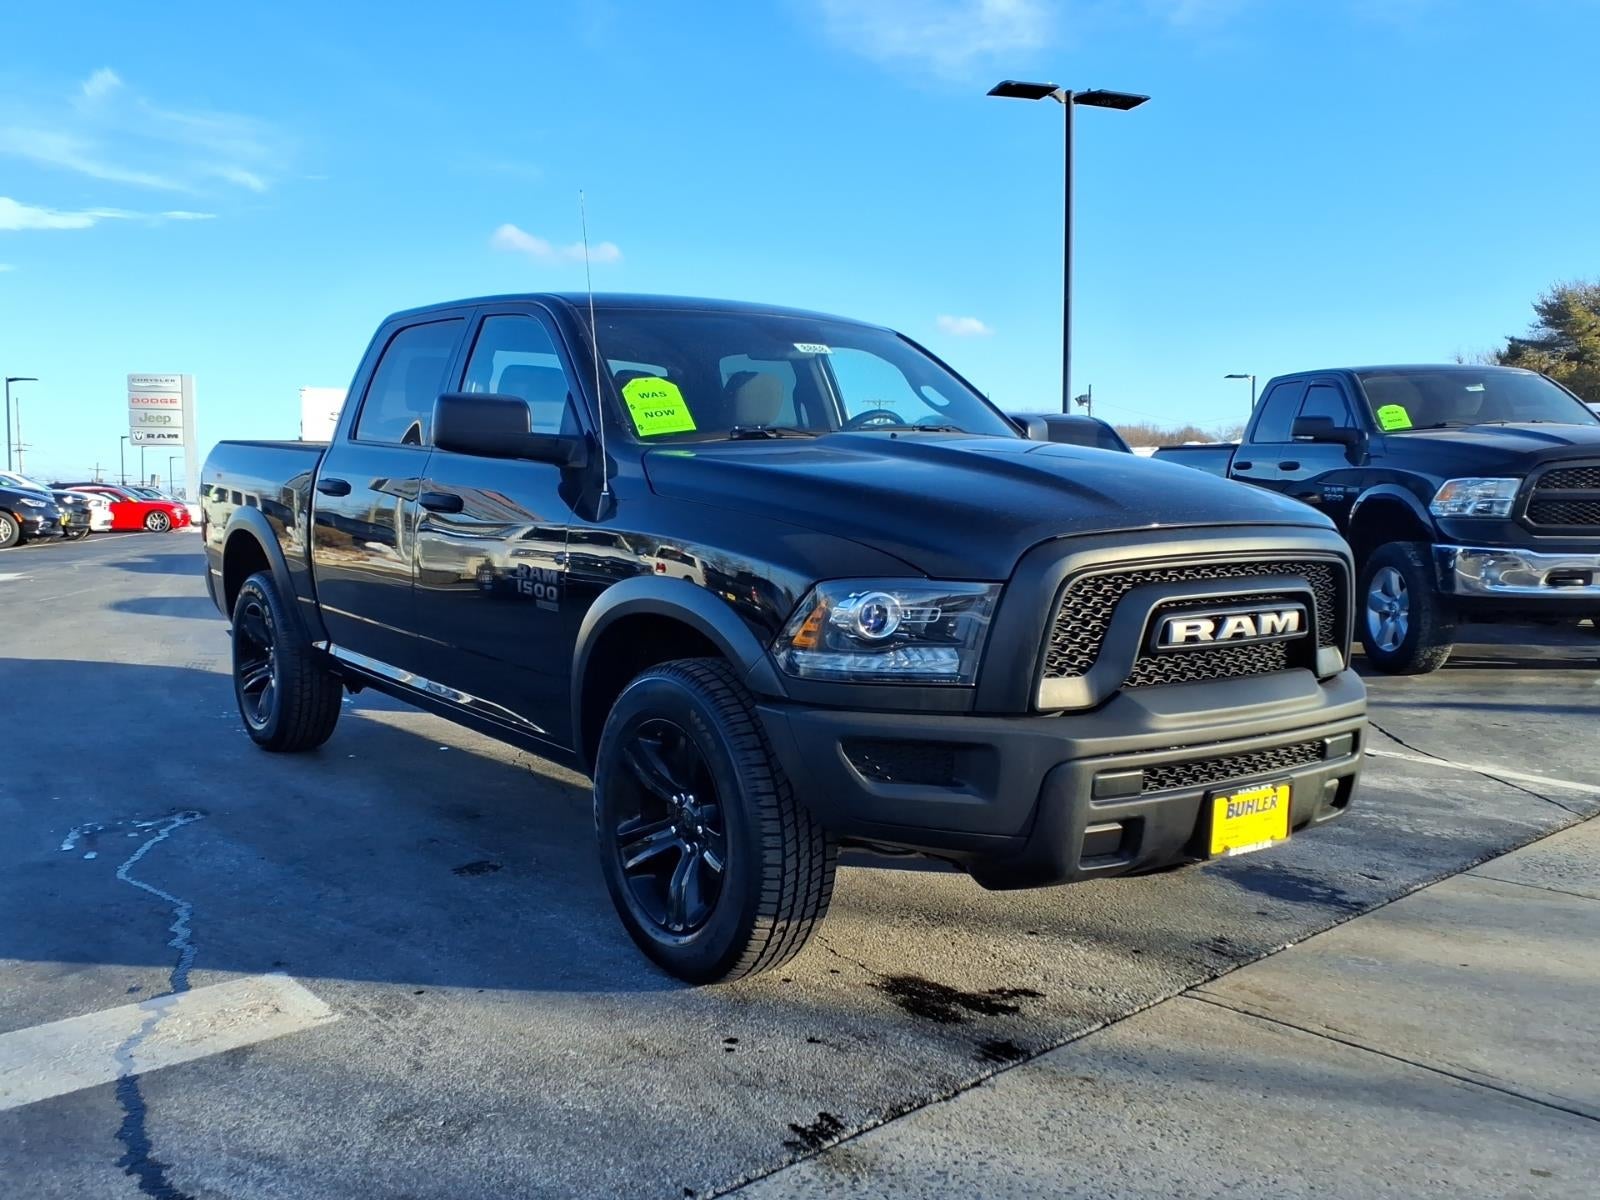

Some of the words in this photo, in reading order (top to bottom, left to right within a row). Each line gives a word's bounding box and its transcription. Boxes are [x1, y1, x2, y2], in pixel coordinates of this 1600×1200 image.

[638, 391, 667, 399] WAS
[139, 412, 171, 425] Jeep
[644, 409, 675, 418] NOW
[516, 563, 558, 585] RAM
[516, 579, 558, 601] 1500
[1168, 610, 1300, 645] RAM
[1226, 794, 1278, 819] BUHLER
